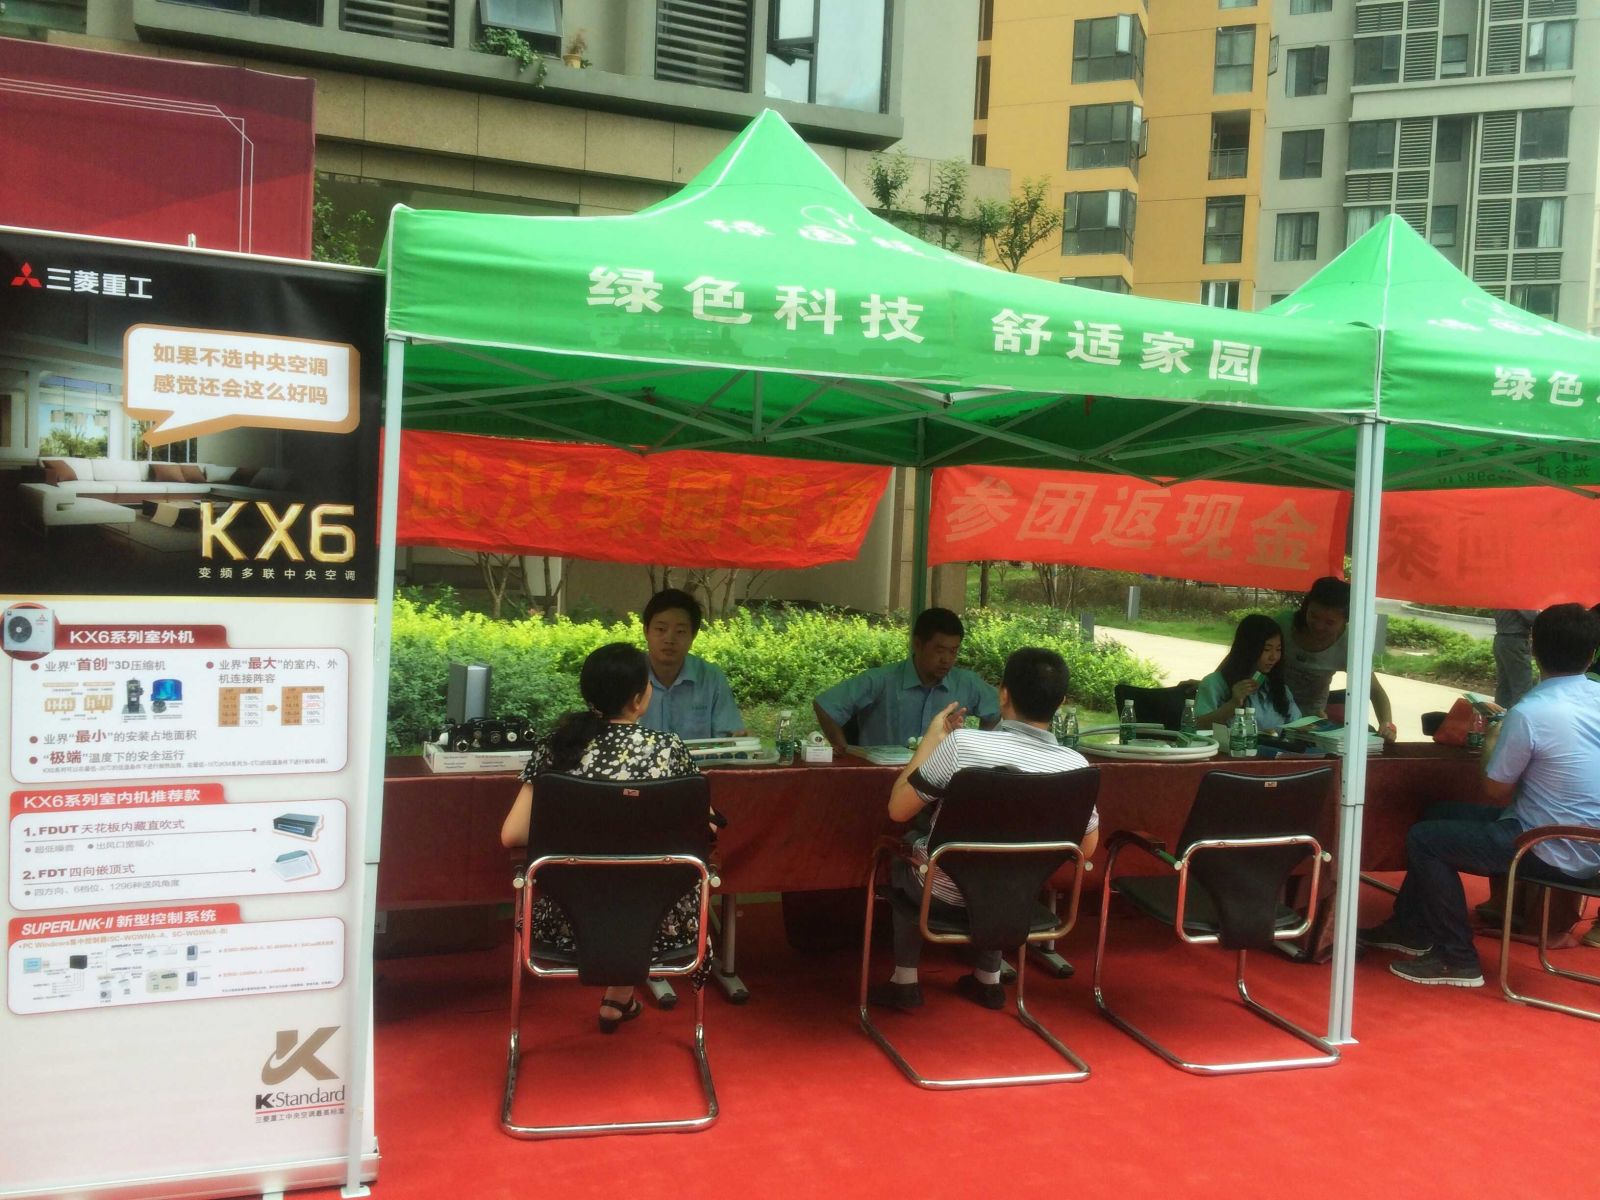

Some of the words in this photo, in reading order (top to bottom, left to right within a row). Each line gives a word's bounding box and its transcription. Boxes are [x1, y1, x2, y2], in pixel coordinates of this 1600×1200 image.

[46, 267, 153, 299] 三菱重工
[586, 266, 926, 344] 绿色科技
[991, 308, 1262, 385] 舒适家园
[153, 342, 329, 377] 如果不选中央空调
[153, 374, 329, 406] 感觉还会这么好吗
[1490, 366, 1600, 407] 绿色
[199, 500, 357, 563] KX6
[945, 475, 1318, 571] 参团返现金
[198, 567, 356, 581] 变频多联中央空调
[69, 629, 195, 645] KX6系列室外机
[23, 788, 200, 809] KX6系列室内机推荐款
[69, 863, 135, 877] 四向嵌顶式
[116, 909, 217, 928] 新型控制系统
